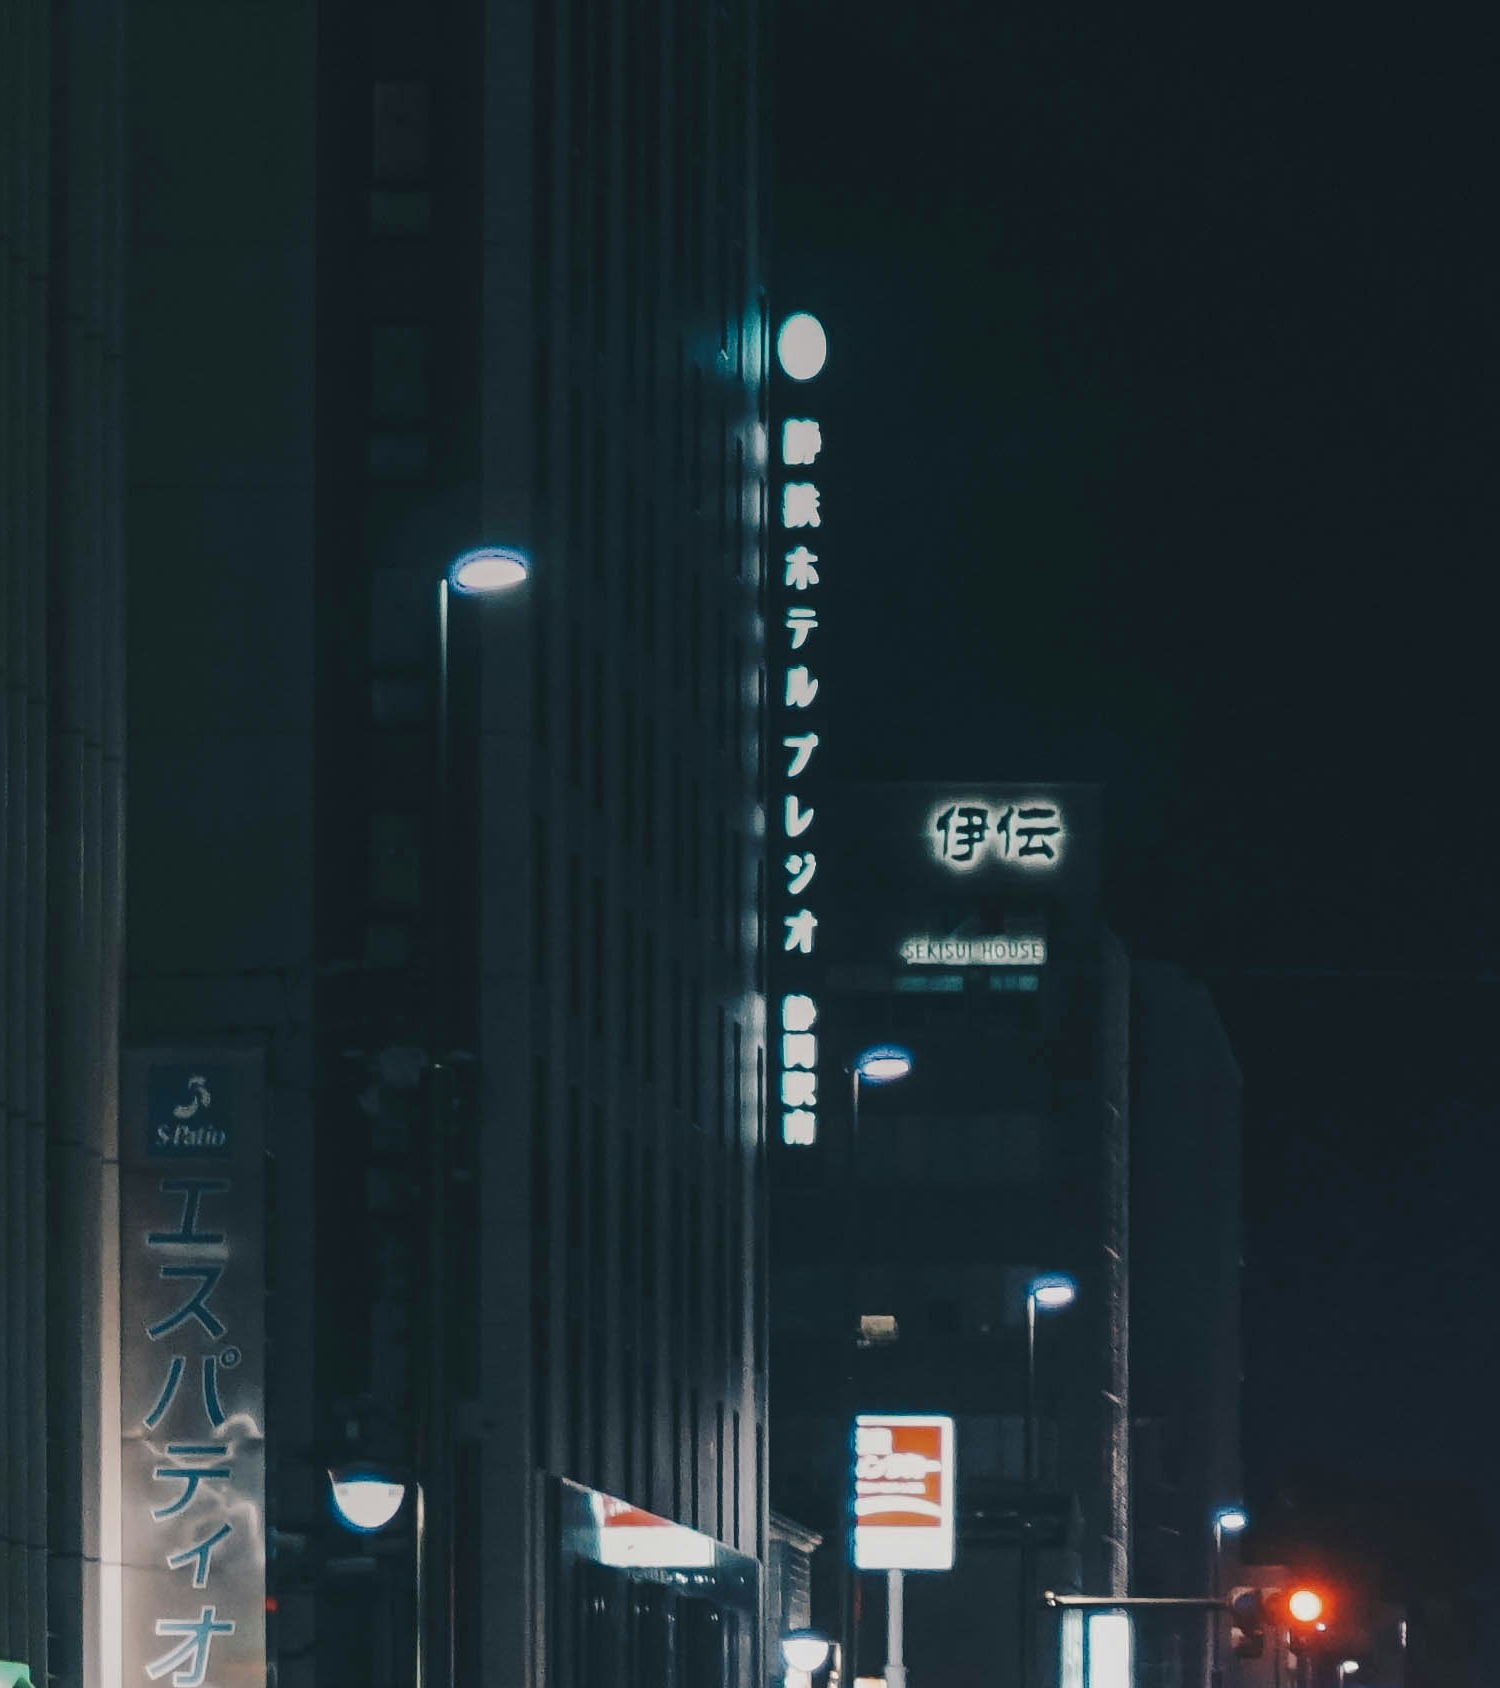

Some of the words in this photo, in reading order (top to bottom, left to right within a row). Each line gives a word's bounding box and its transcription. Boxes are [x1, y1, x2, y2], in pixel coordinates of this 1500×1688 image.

[933, 805, 1062, 862] 伊伝
[905, 941, 973, 960] SEKISUI
[981, 941, 1043, 960] HOUSE
